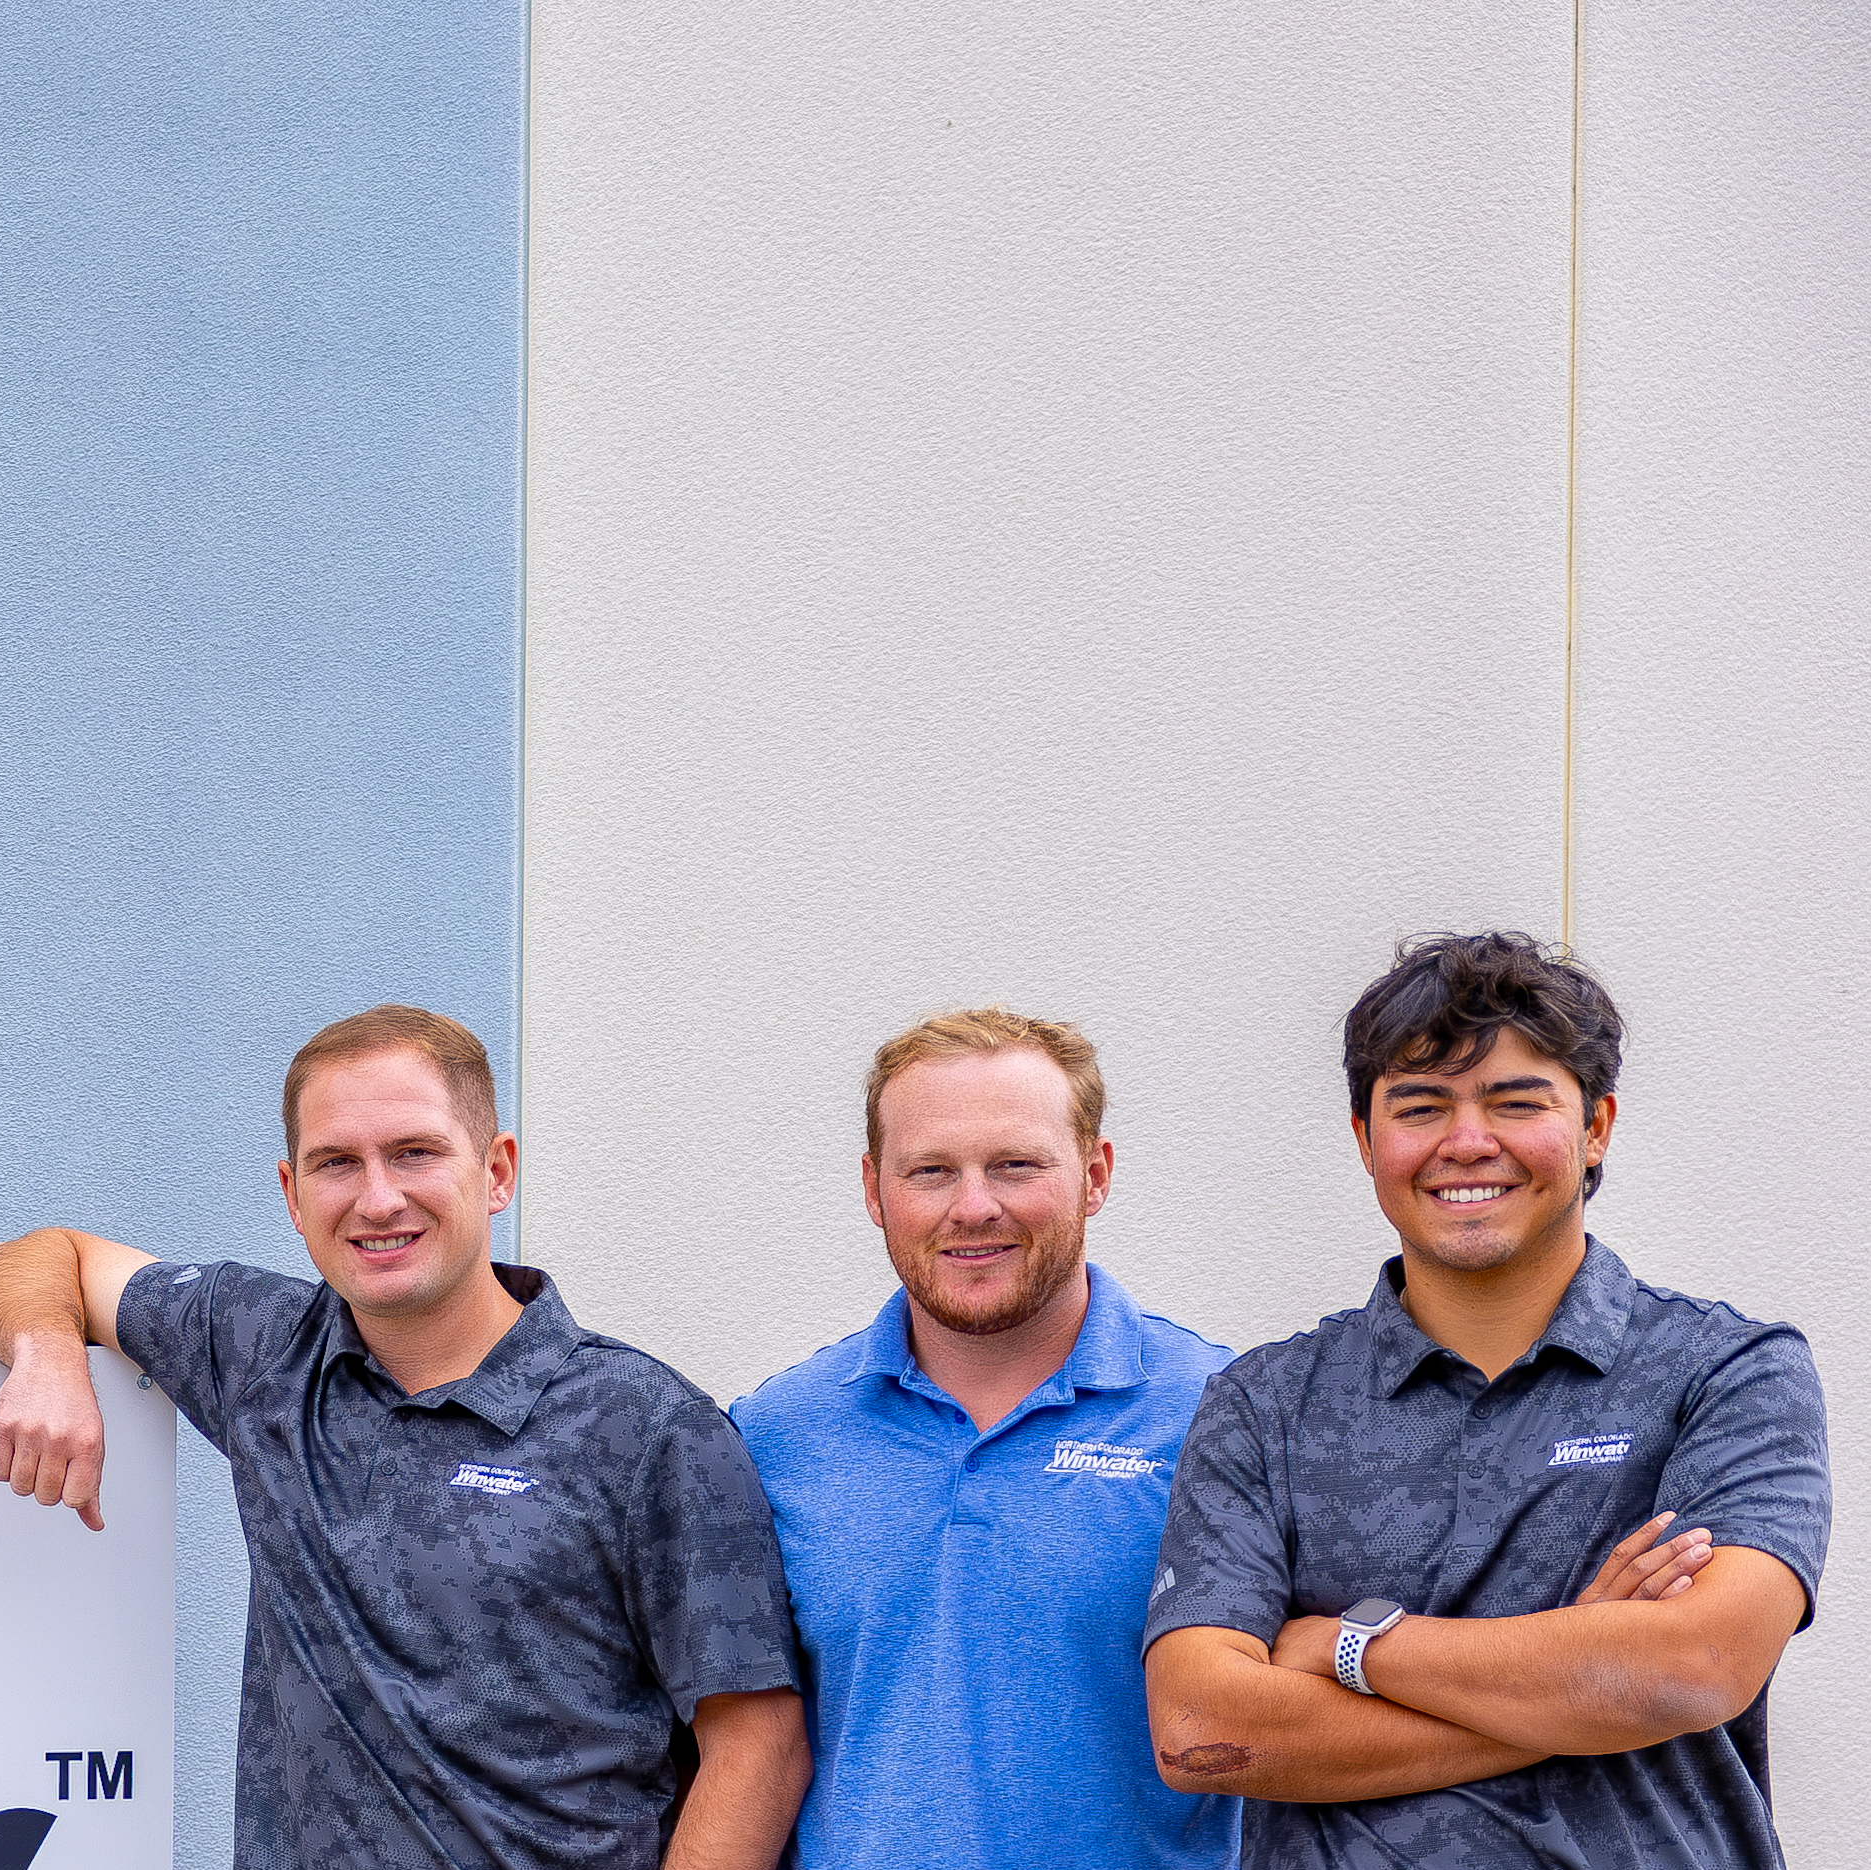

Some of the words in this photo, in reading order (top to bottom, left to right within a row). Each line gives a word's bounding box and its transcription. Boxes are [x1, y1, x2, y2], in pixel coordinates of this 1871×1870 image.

[1098, 1442, 1143, 1456] COLORADO
[491, 1466, 525, 1478] COLORADO
[1053, 1449, 1163, 1474] Winwater
[456, 1469, 531, 1493] Winwater
[44, 1750, 135, 1802] TM
